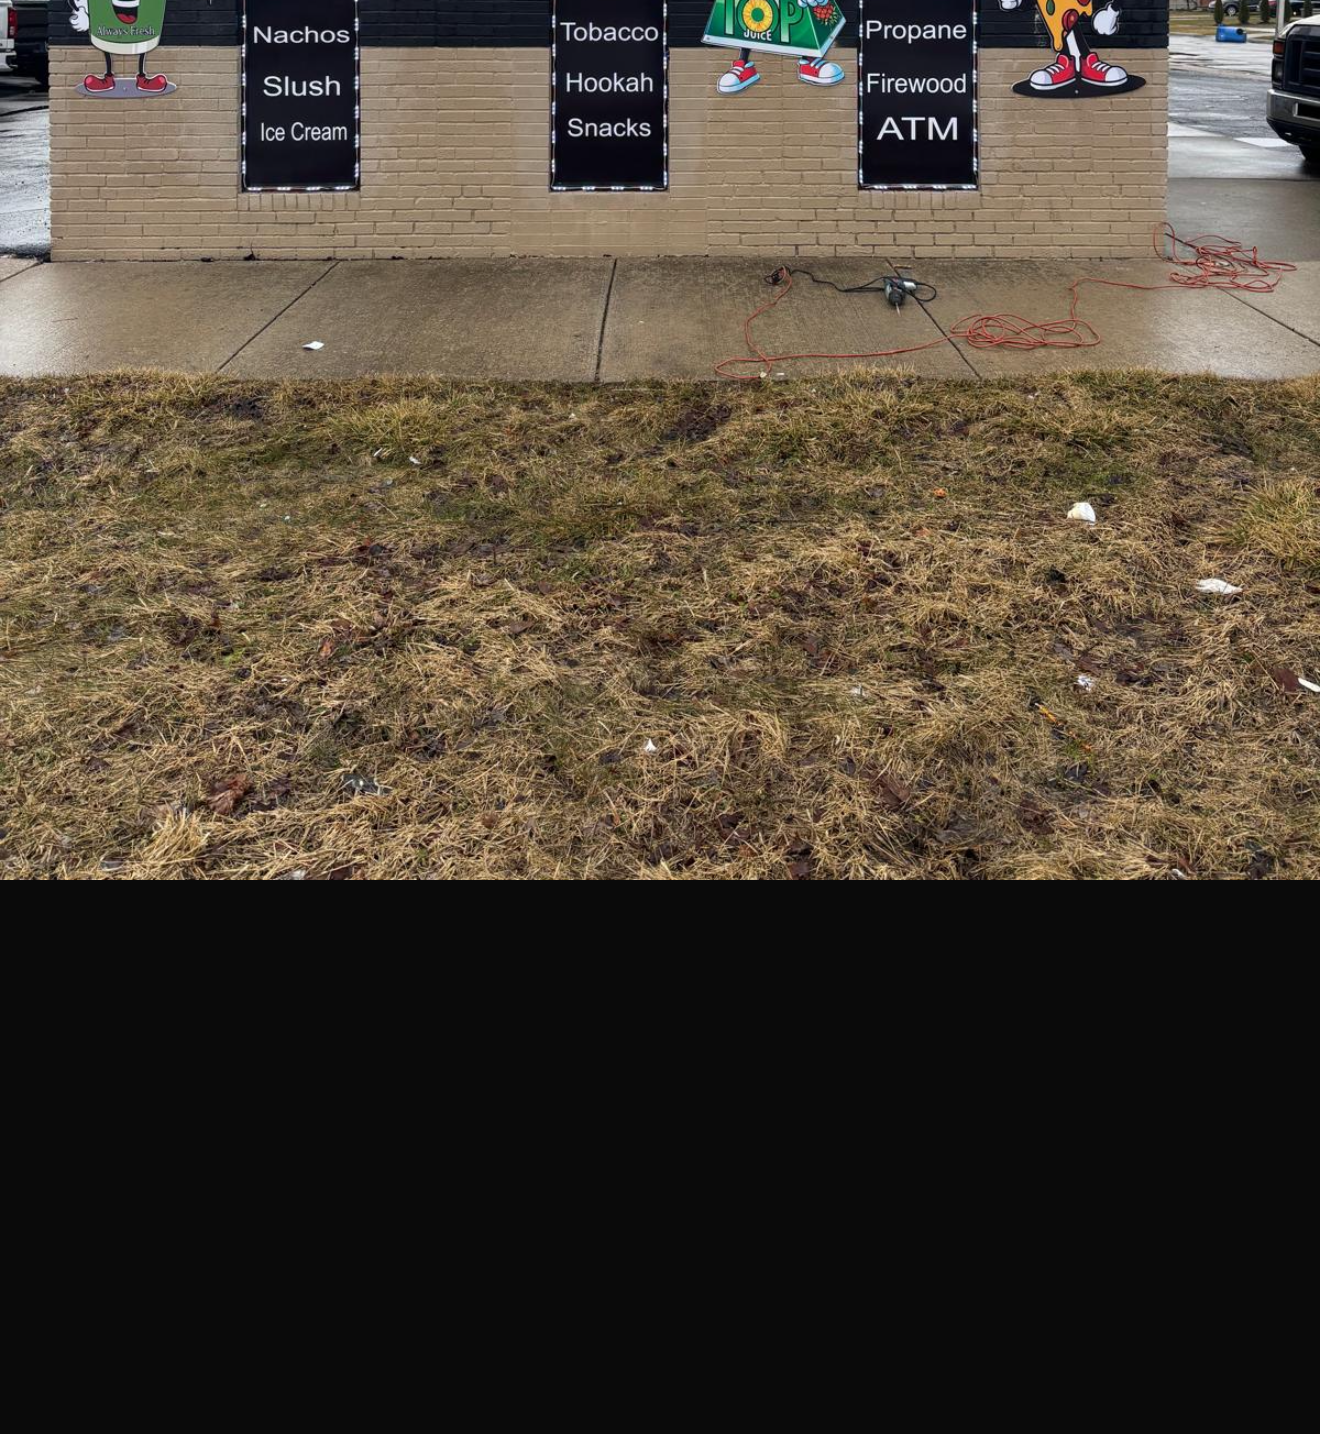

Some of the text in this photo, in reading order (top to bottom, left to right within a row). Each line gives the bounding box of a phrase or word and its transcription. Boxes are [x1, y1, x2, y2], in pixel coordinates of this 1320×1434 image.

[97, 25, 155, 37] Always Fresh
[253, 25, 350, 44] Nachos
[560, 22, 659, 42] Tobacco
[743, 29, 772, 41] JUICE
[866, 20, 967, 44] Propane
[263, 75, 341, 97] Slush
[566, 72, 653, 93] Hookah
[867, 73, 967, 94] Firewood
[261, 121, 348, 142] Ice Cream
[567, 118, 651, 137] Snacks
[876, 116, 958, 141] ATM
